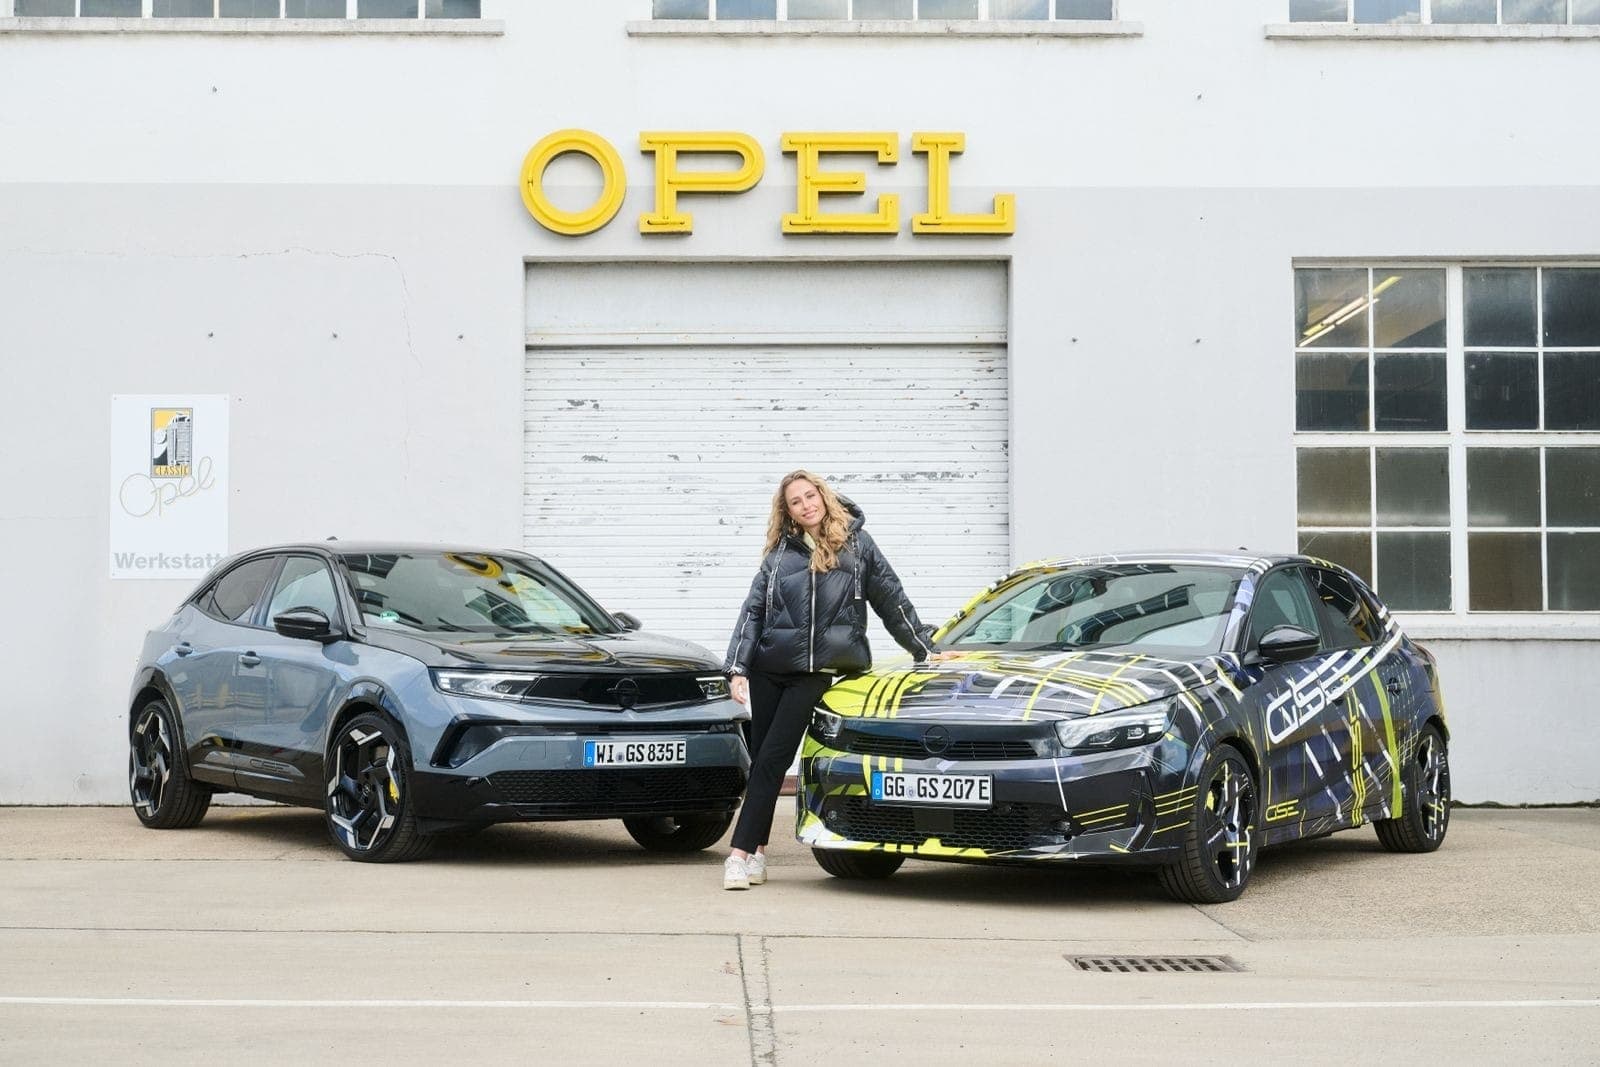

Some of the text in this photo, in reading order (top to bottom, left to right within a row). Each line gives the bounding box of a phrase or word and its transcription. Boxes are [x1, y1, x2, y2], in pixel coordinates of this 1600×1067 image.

[519, 128, 1015, 237] OPEL
[153, 465, 188, 476] CLASSIC
[119, 456, 215, 517] Opel
[597, 744, 614, 763] WI
[884, 776, 905, 797] GG
